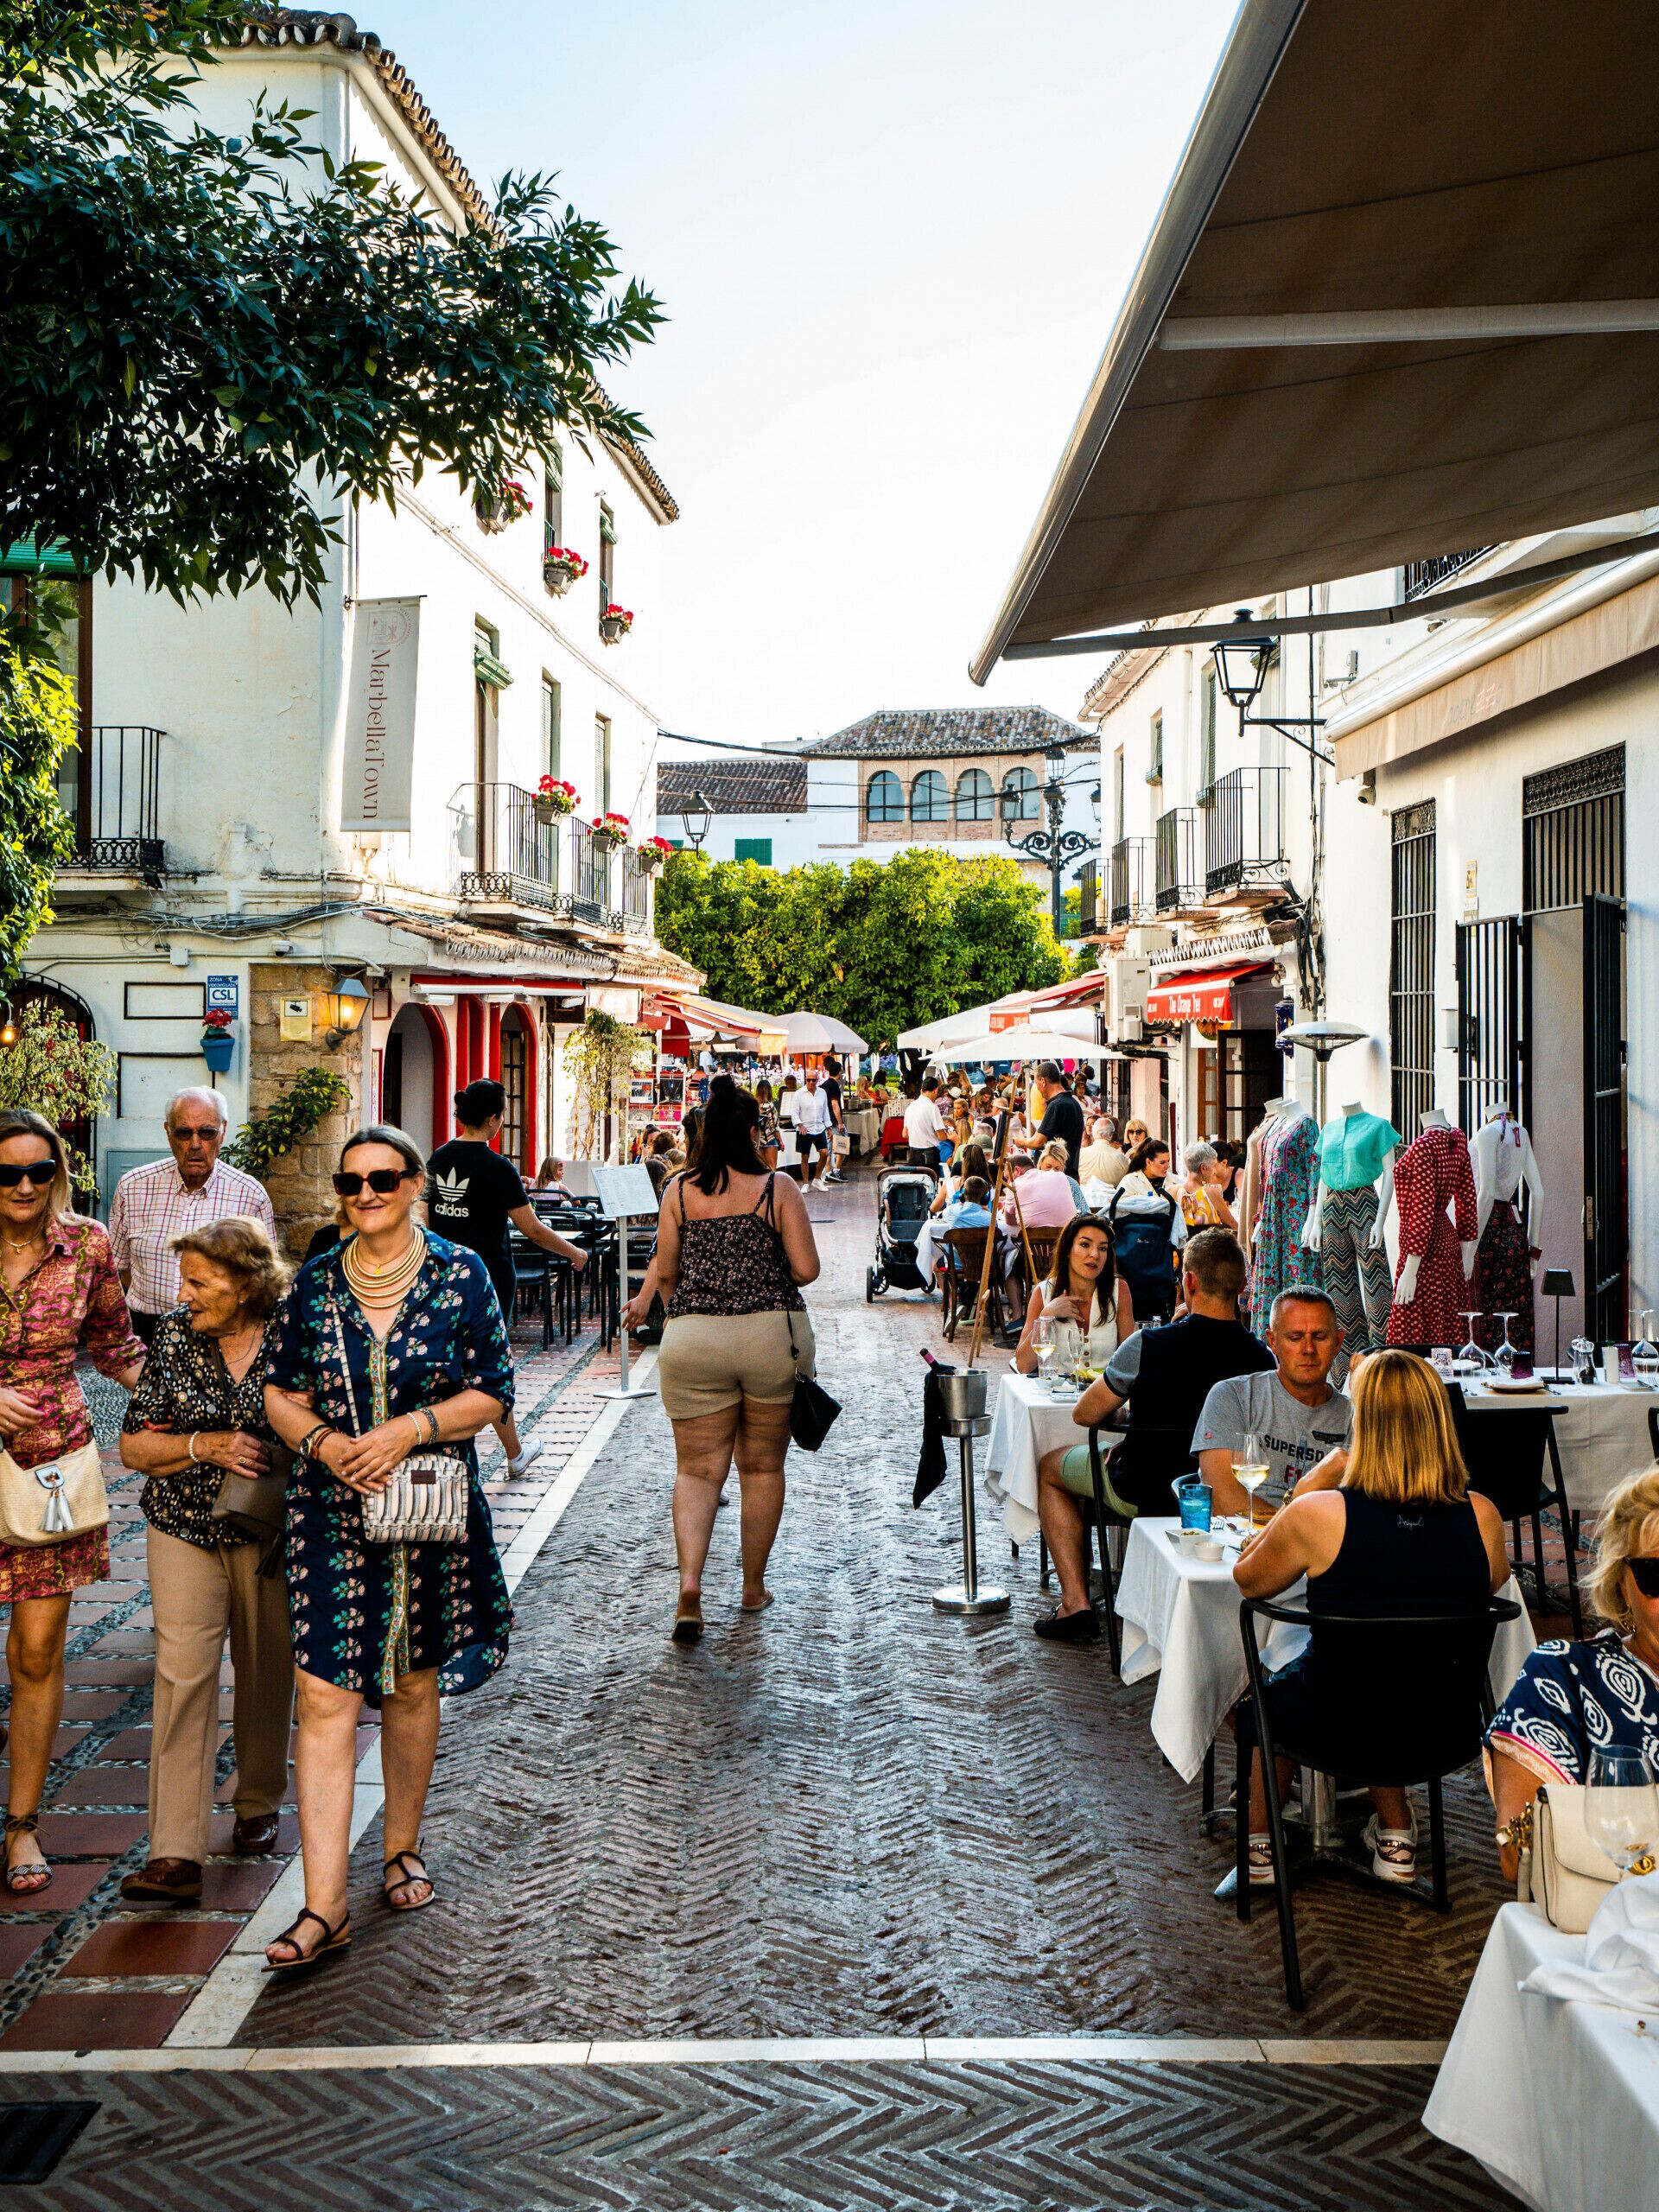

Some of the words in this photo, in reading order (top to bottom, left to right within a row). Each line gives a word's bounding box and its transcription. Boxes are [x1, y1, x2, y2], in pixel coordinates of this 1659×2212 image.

[213, 989, 234, 1000] CSL
[1177, 995, 1191, 1019] Orange
[1192, 993, 1201, 1013] Tree
[435, 1202, 469, 1217] adidas
[1284, 1465, 1303, 1484] F1
